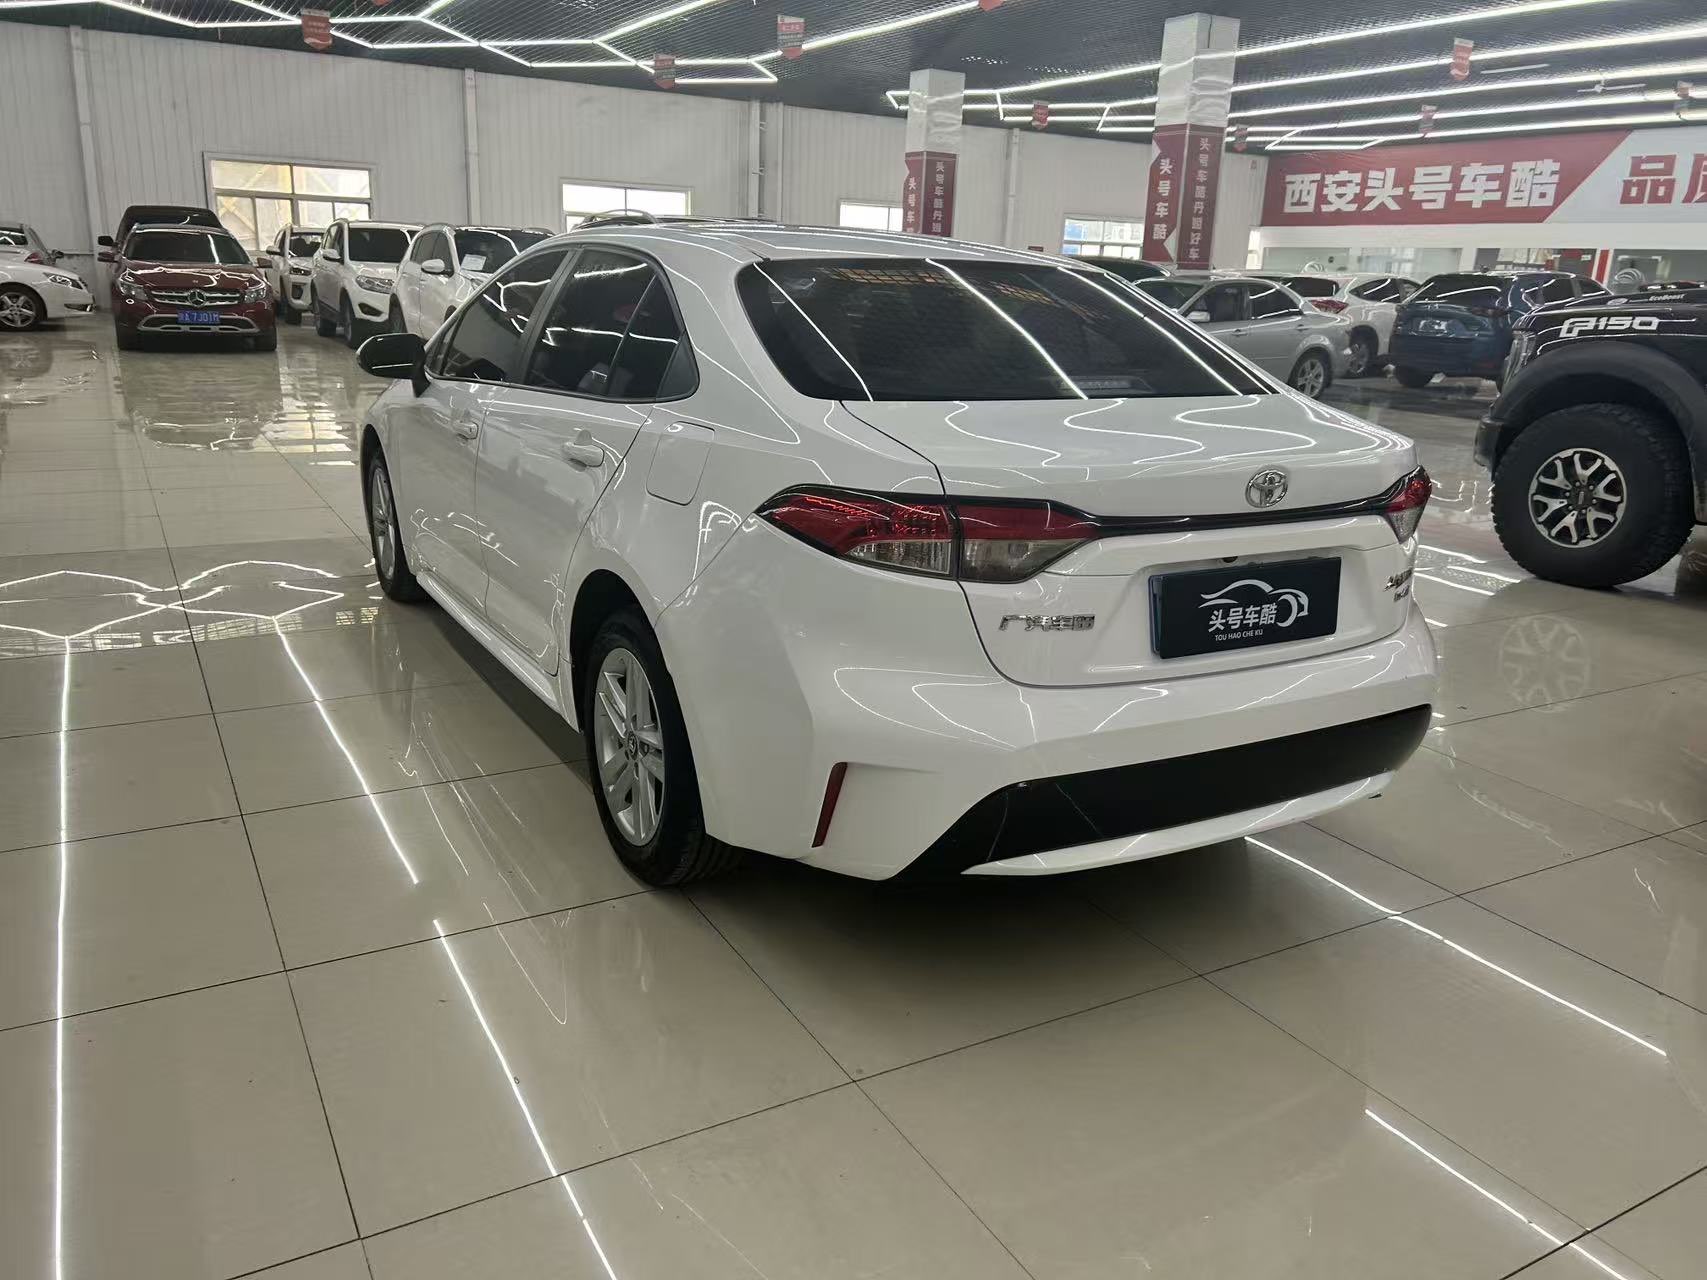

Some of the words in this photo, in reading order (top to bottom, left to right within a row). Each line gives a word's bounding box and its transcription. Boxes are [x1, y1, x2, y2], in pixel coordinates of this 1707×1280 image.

[1152, 158, 1173, 240] 头号车酷
[1282, 158, 1561, 214] 西安头号车酷
[1207, 602, 1278, 633] 头号车酷
[1228, 631, 1242, 640] HAO
[1242, 630, 1255, 638] CHE
[1255, 629, 1263, 637] KU
